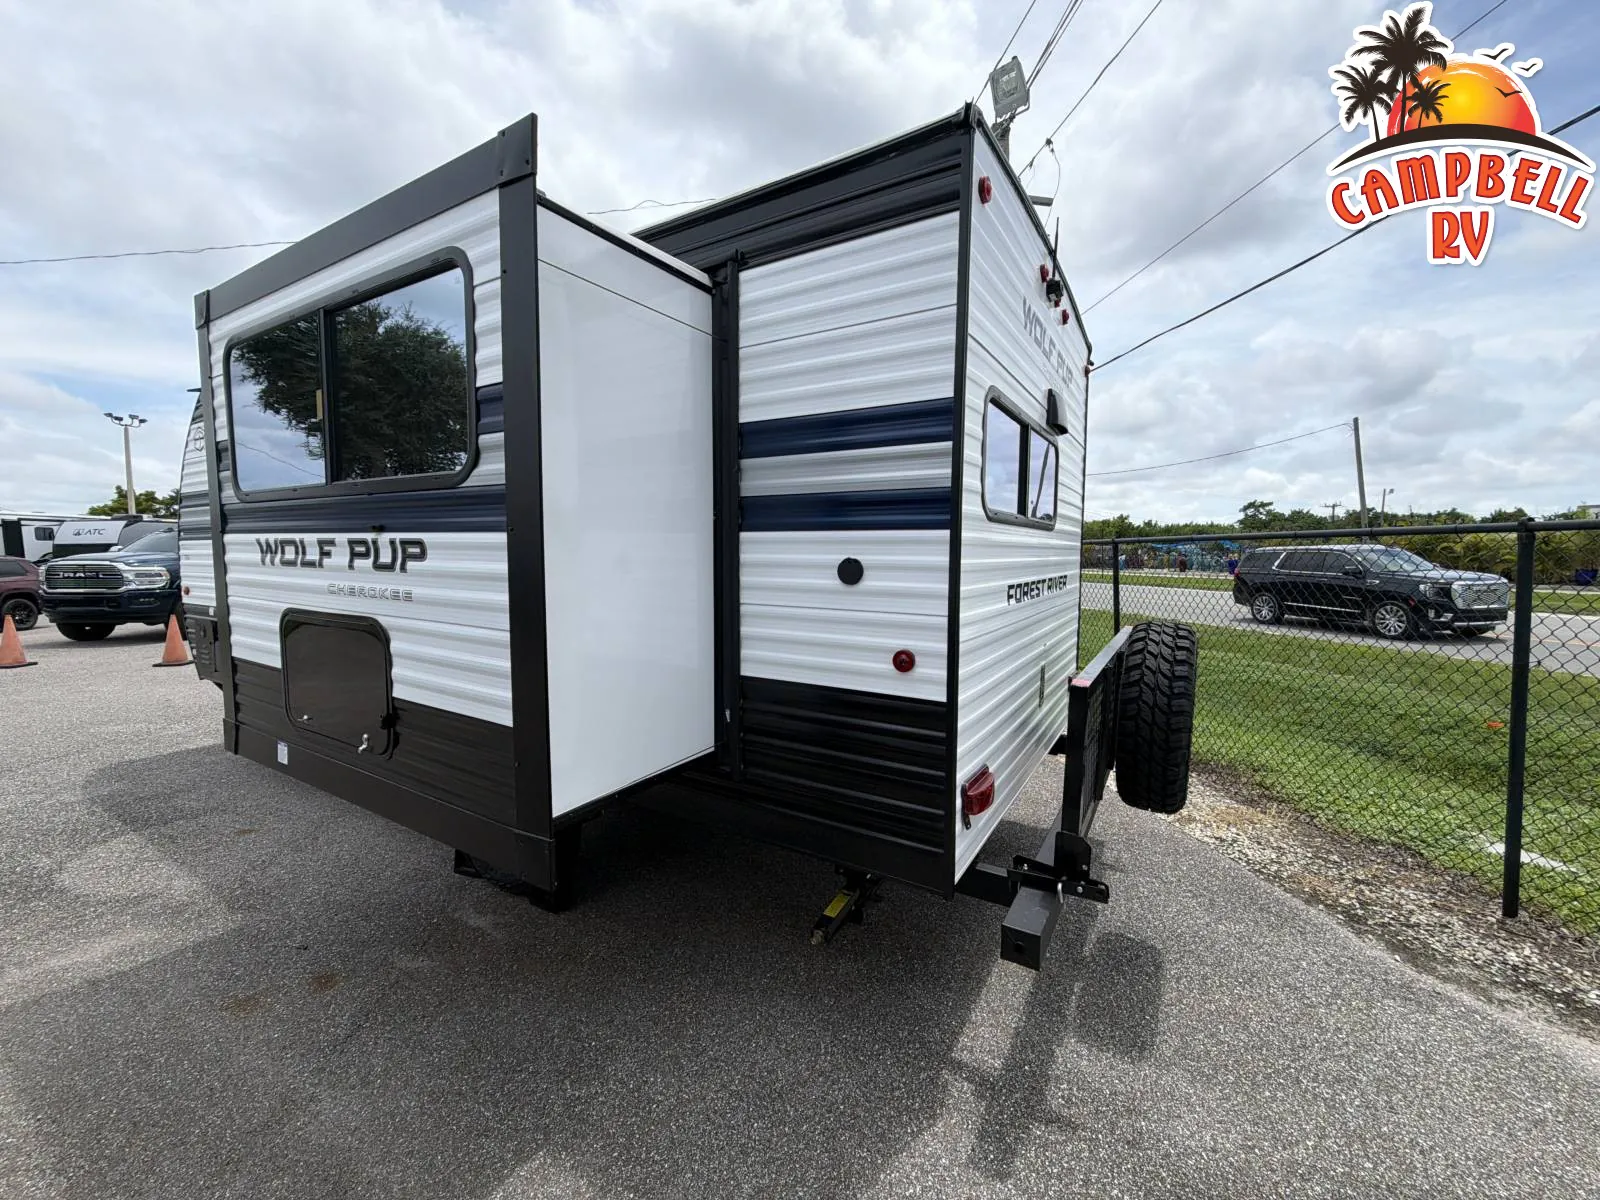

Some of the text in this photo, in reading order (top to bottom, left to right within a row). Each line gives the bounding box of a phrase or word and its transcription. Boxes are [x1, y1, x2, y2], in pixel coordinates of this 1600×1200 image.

[1022, 295, 1056, 362] WOLF
[84, 528, 106, 536] ATC
[255, 537, 428, 574] WOLF PUP
[326, 582, 413, 602] CHEROKEE
[1007, 574, 1068, 606] FOREST RIVER
